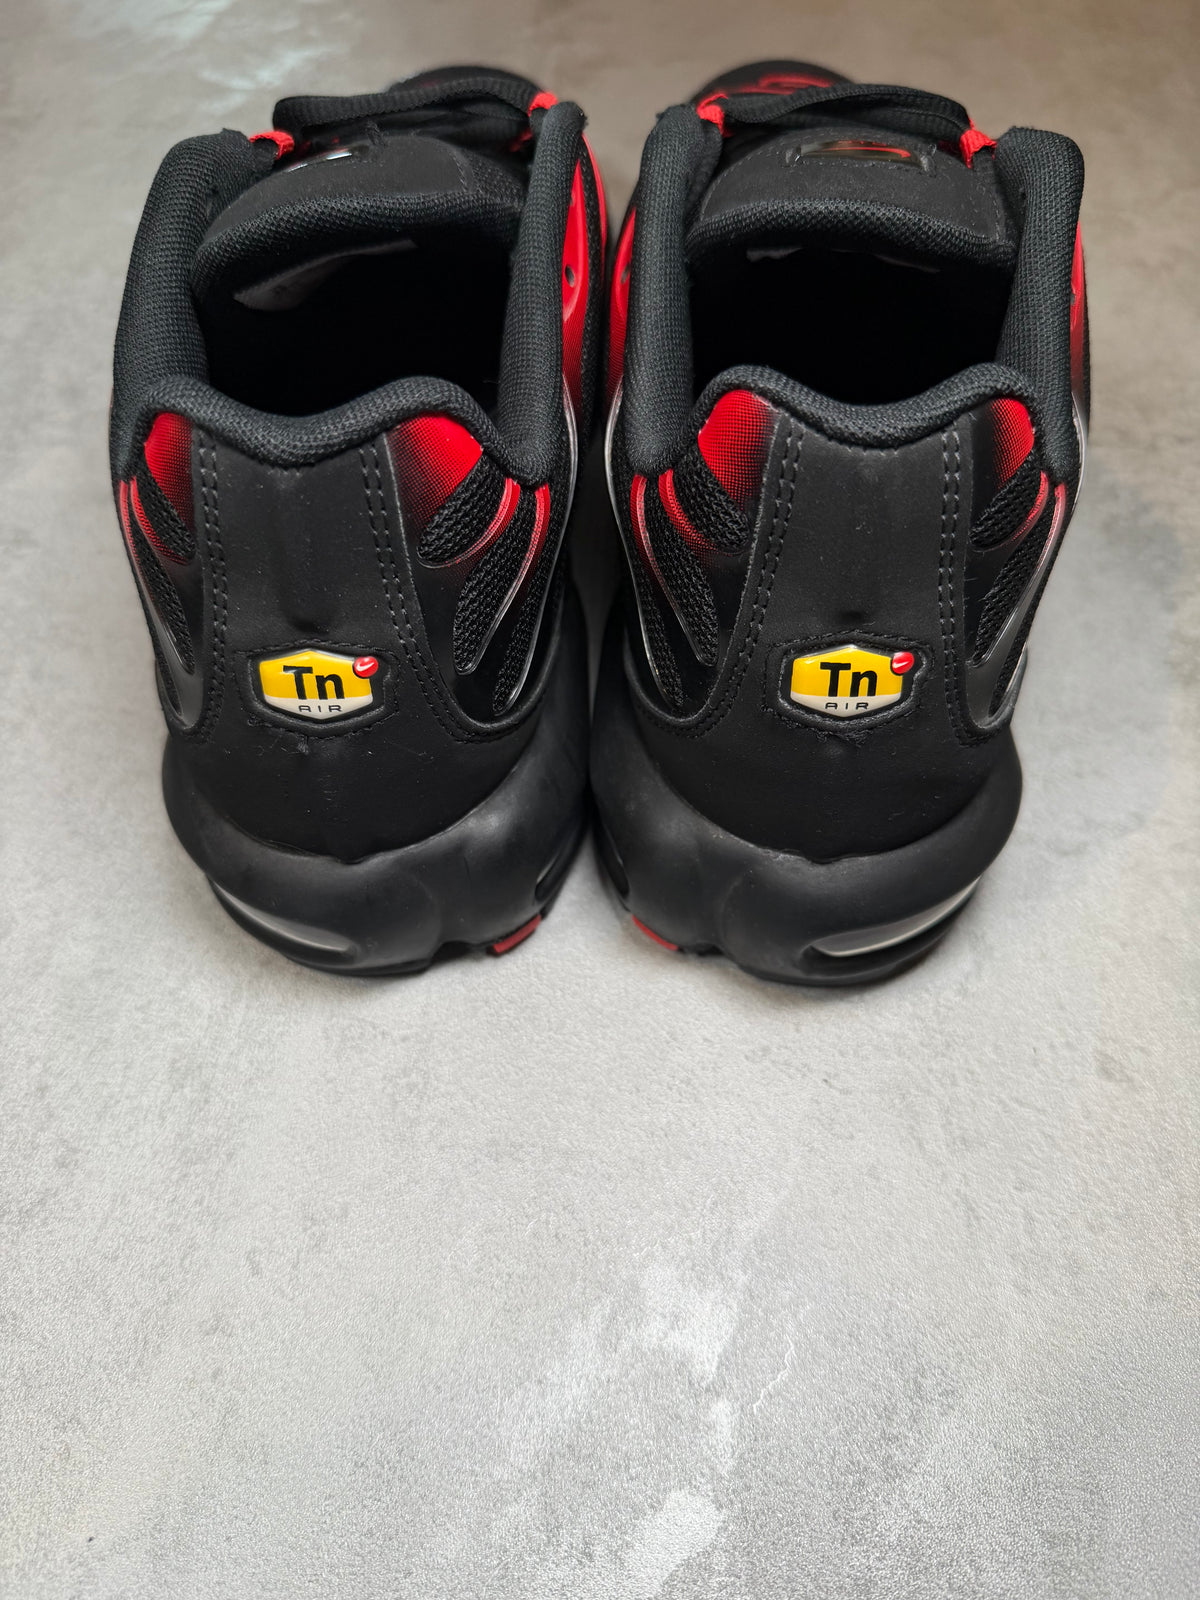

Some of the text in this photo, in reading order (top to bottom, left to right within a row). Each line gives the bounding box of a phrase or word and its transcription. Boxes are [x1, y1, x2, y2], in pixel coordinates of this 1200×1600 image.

[283, 665, 345, 700] Tn
[820, 662, 878, 697] Tn
[298, 704, 343, 713] AIR
[825, 702, 869, 711] AIR
